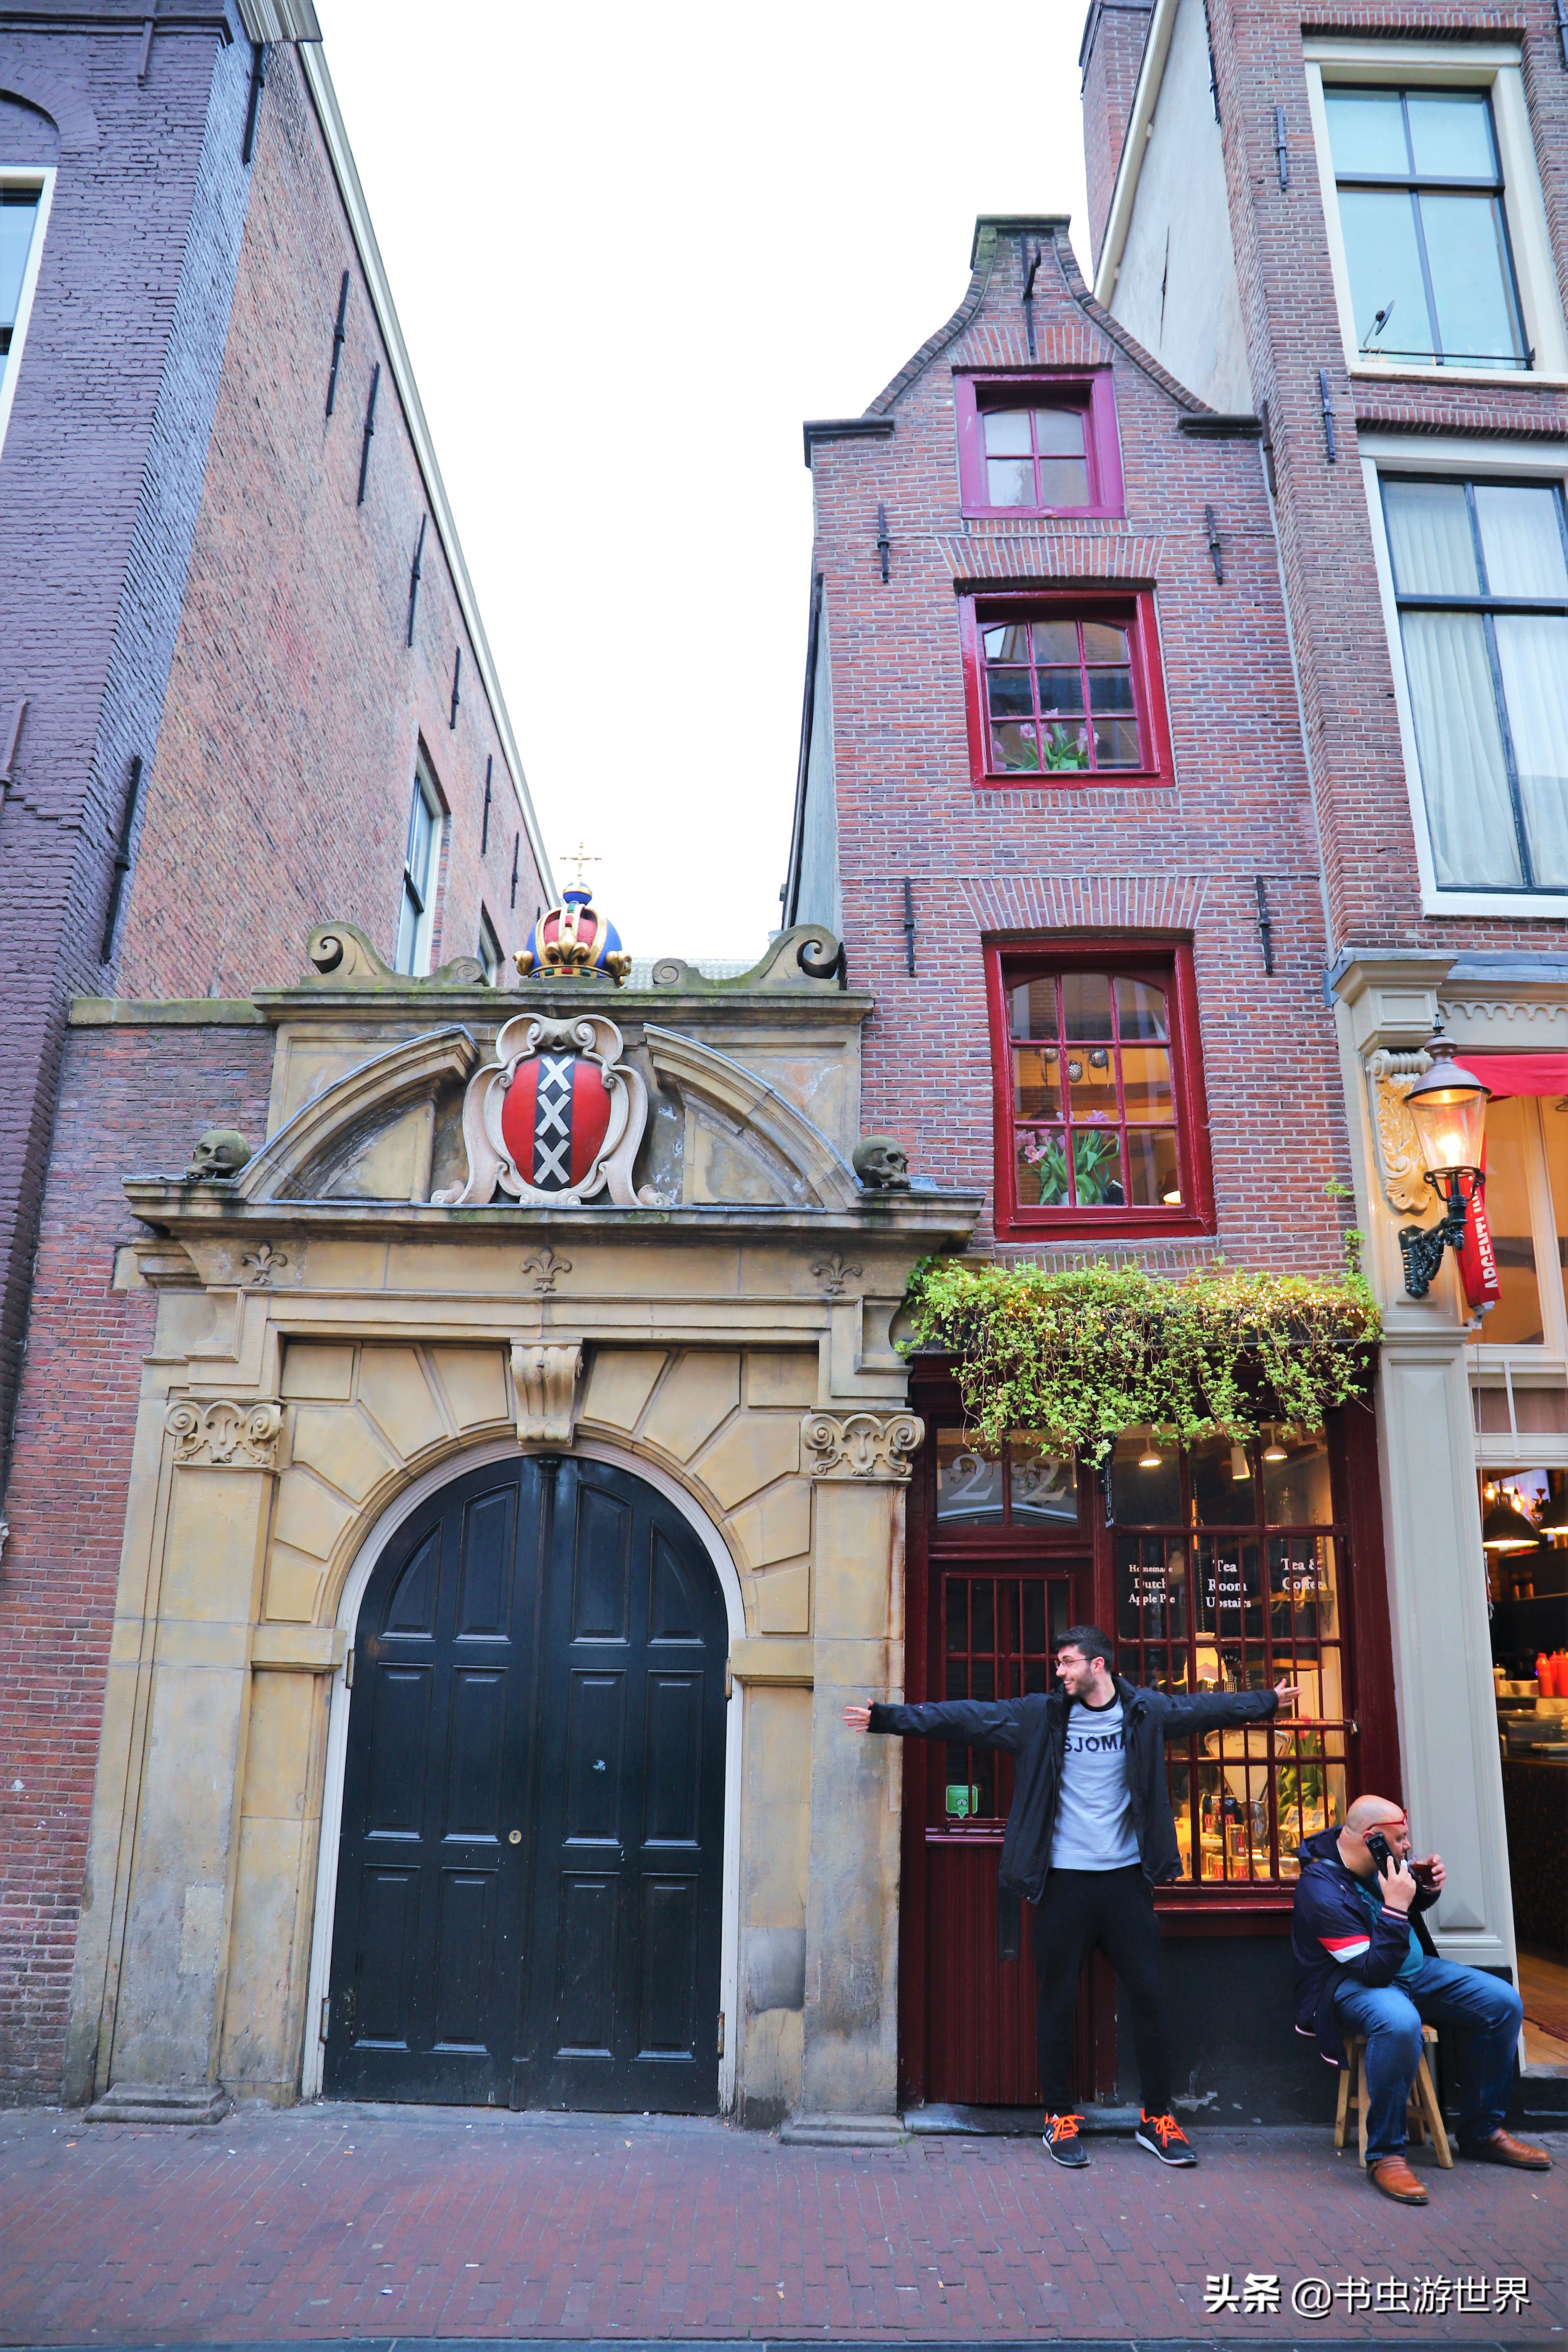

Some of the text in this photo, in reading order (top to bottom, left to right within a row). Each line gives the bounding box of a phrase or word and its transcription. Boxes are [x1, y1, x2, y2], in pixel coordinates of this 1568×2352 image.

[948, 1453, 1066, 1501] 22
[1212, 1559, 1237, 1572] Tea
[1280, 1558, 1306, 1570] Tea
[1208, 1579, 1248, 1591] Room
[1282, 1576, 1324, 1590] Coffee
[1159, 1594, 1175, 1603] Pe
